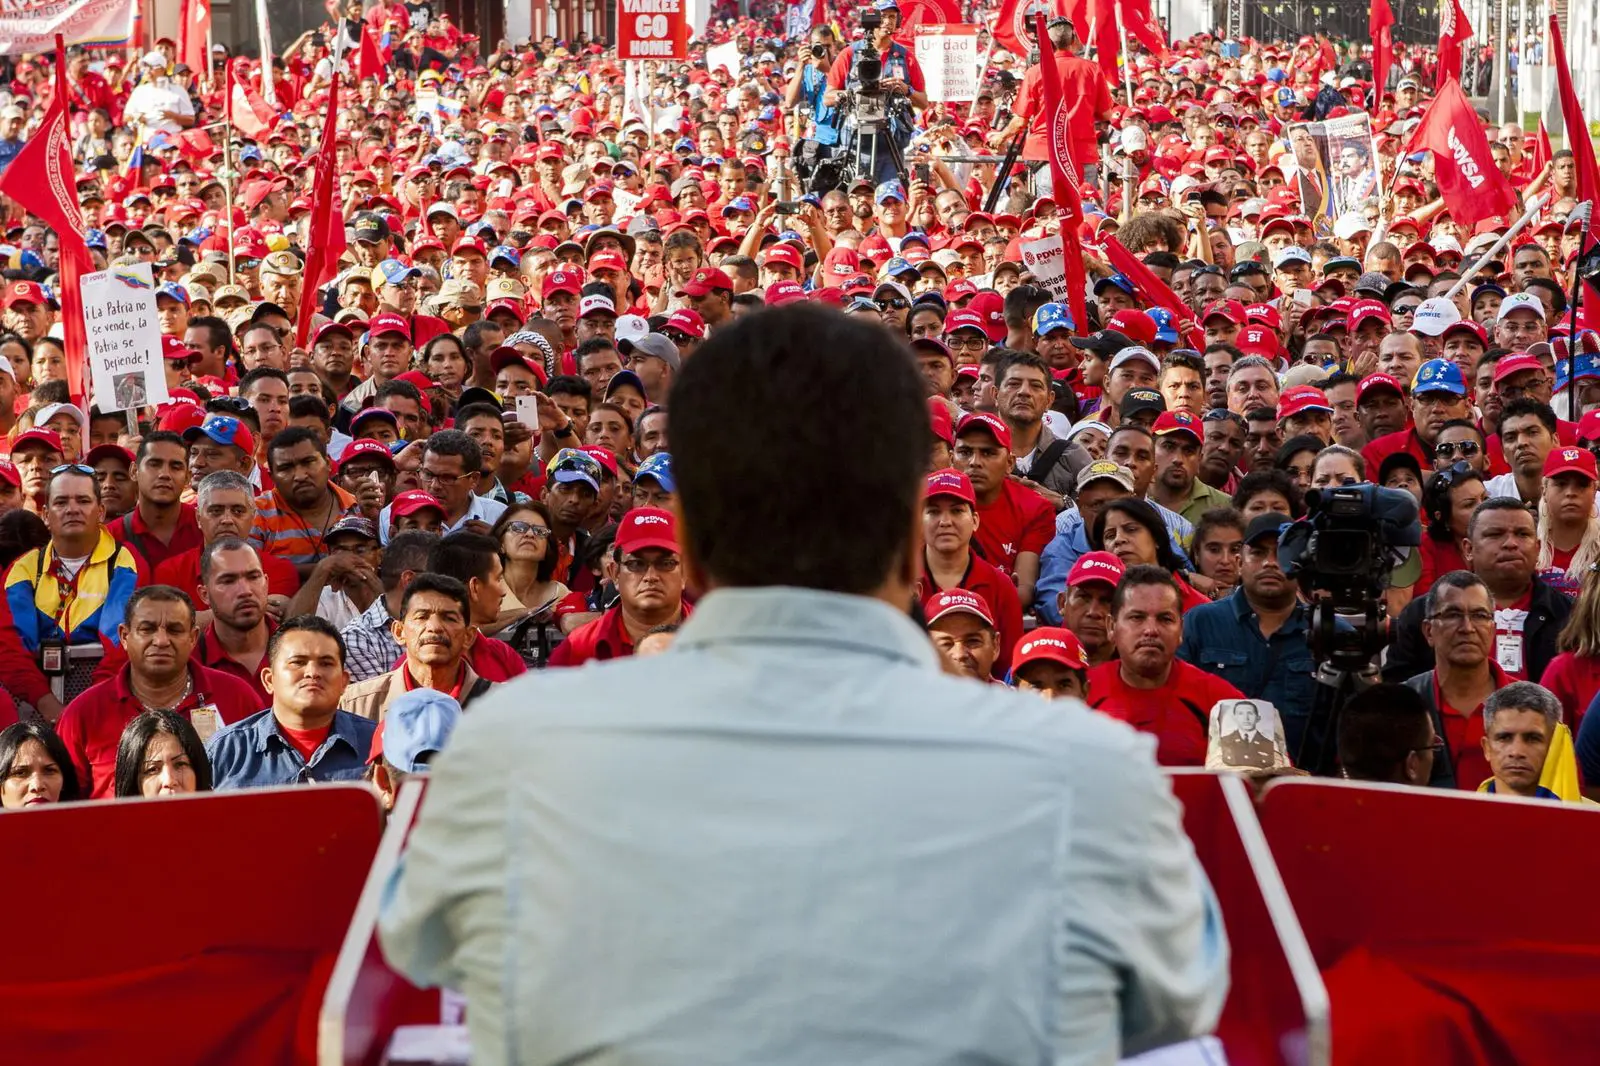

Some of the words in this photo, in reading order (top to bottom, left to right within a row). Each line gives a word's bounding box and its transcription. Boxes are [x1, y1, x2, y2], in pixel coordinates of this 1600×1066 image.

[622, 0, 680, 13] YANKEE
[635, 14, 668, 38] GO
[629, 40, 673, 56] HOME
[1453, 136, 1485, 189] PDVSA
[1036, 247, 1063, 260] PDVS
[107, 299, 133, 317] Patria
[136, 301, 147, 312] no
[92, 325, 102, 336] se
[138, 317, 147, 329] la
[94, 340, 119, 356] Patria
[122, 339, 135, 349] se
[1094, 561, 1121, 574] PDVSA
[1033, 638, 1067, 649] PDVSA
